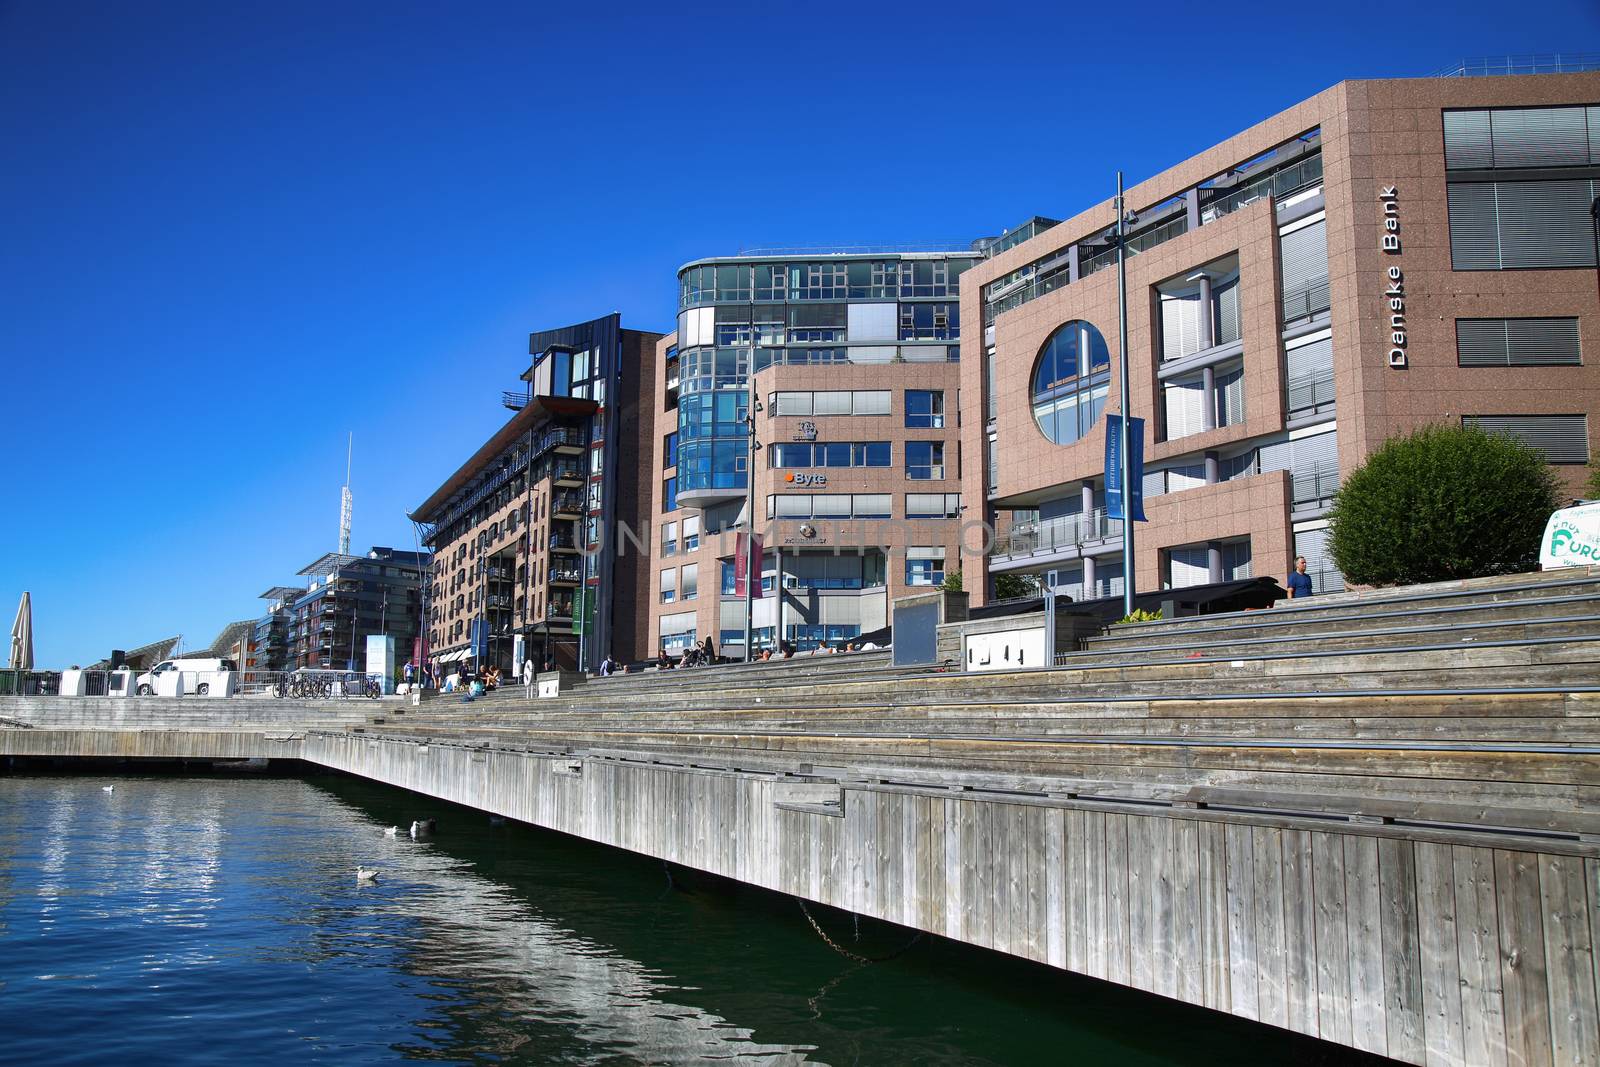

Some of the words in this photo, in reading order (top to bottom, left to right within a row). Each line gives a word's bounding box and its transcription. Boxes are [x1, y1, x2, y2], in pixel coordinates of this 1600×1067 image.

[1380, 185, 1399, 250] Bank
[1385, 266, 1405, 367] Danske
[795, 472, 827, 486] Byte
